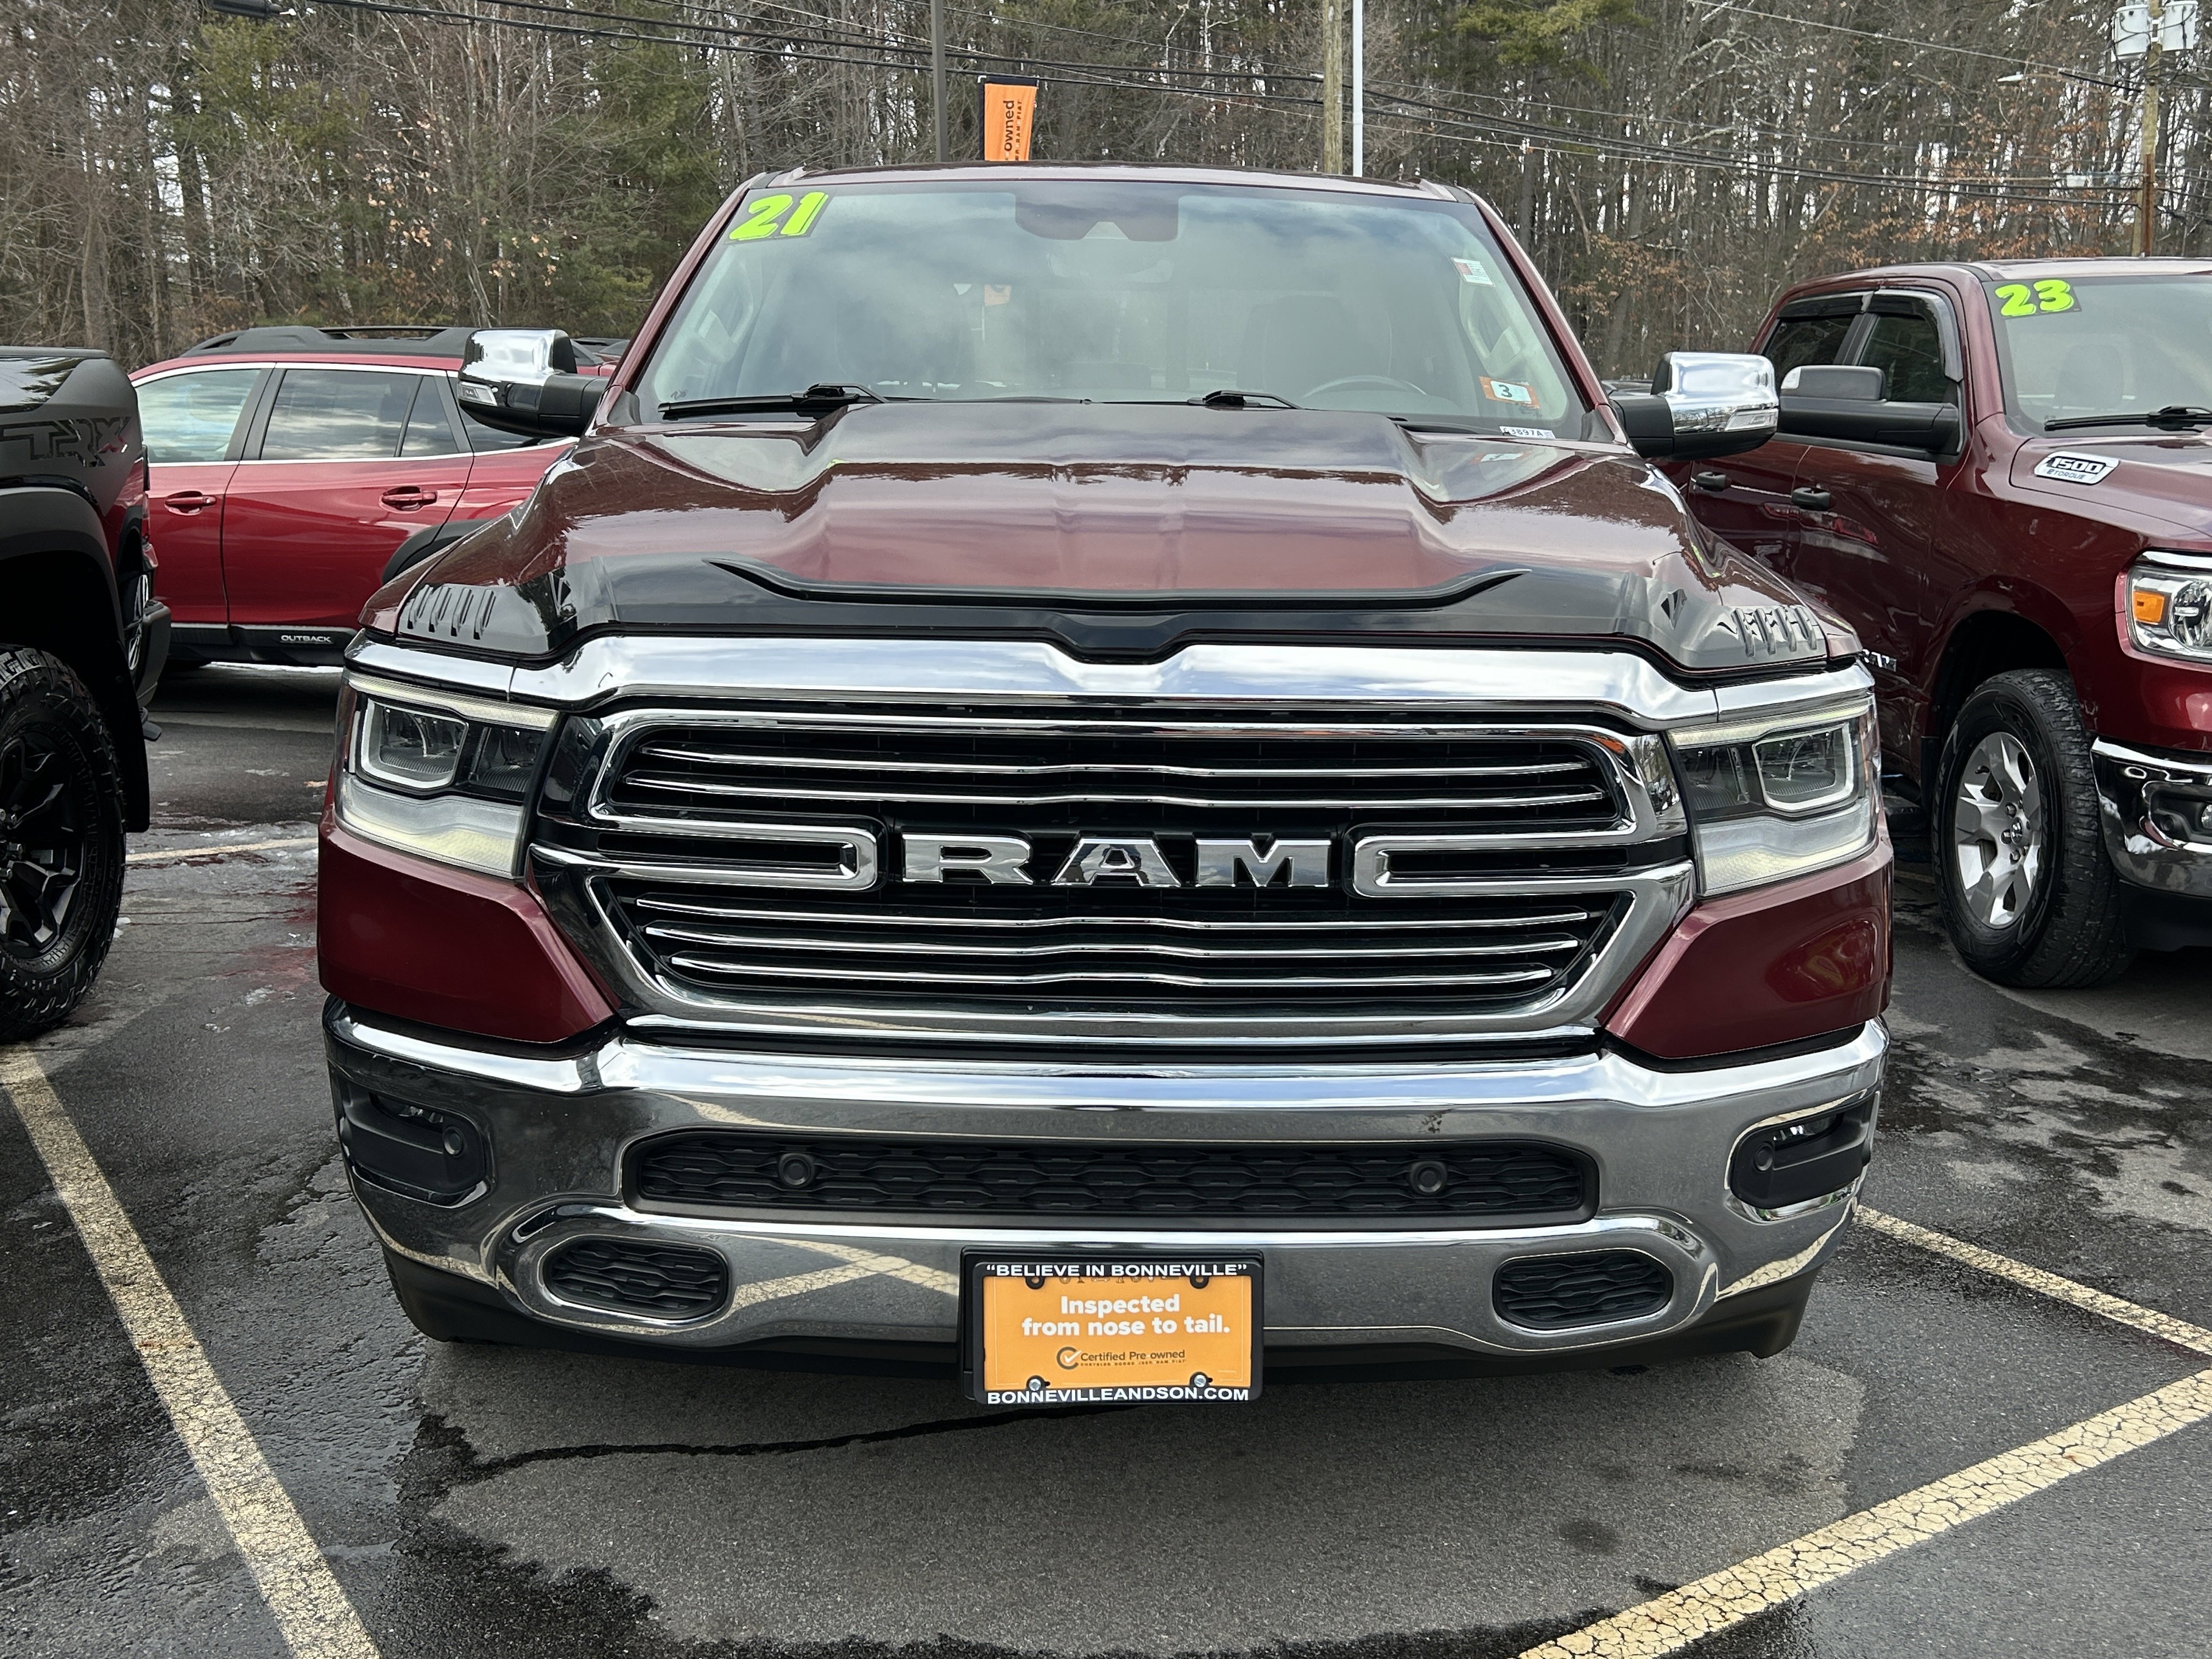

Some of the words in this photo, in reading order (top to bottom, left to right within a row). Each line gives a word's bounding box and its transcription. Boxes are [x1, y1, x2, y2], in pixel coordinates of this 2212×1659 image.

[729, 192, 829, 241] 21
[1995, 280, 2074, 316] 23
[1498, 385, 1513, 398] 3
[0, 417, 132, 467] TRX
[2052, 458, 2104, 473] 1500
[902, 833, 1332, 888] RAM
[1086, 1265, 1105, 1276] IN
[1060, 1294, 1180, 1318] Inspected
[1022, 1317, 1080, 1336] from
[1088, 1318, 1146, 1335] nose
[1153, 1316, 1177, 1334] to
[1184, 1313, 1231, 1333] tail.
[1080, 1352, 1126, 1362] Certified
[987, 1386, 1249, 1404] BONNEVILLEANDSON.COM
